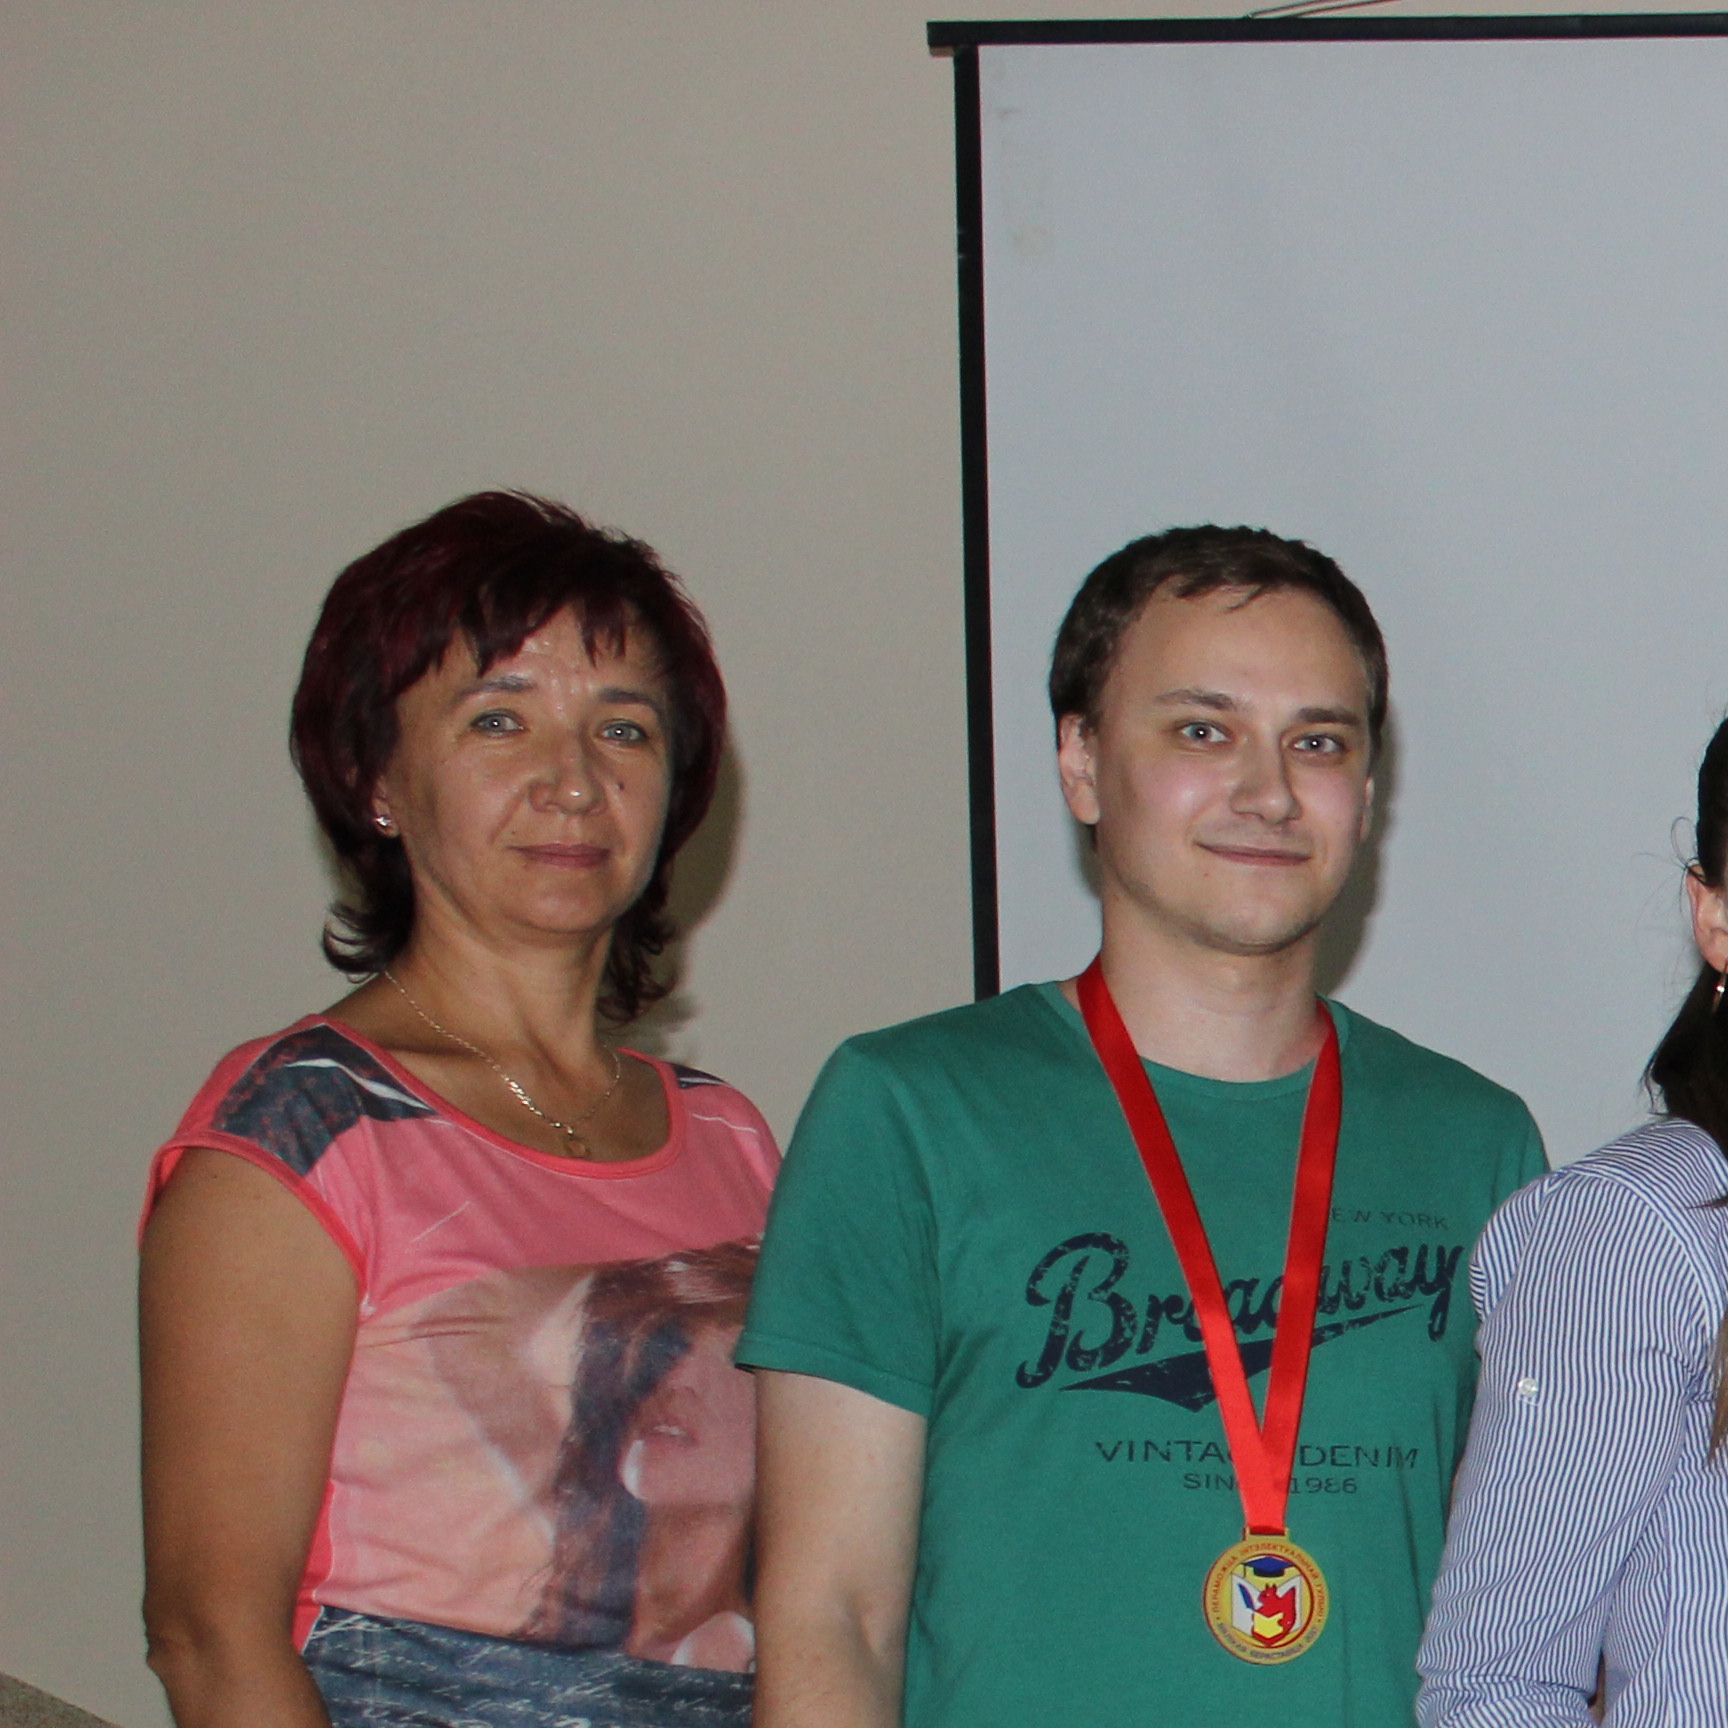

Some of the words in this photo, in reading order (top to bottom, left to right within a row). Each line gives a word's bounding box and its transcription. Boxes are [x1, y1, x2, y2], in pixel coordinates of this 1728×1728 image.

[1381, 1210, 1450, 1230] YORK
[1096, 1440, 1233, 1463] VINTA
[1300, 1445, 1419, 1469] DENIM
[1183, 1473, 1236, 1490] SIN
